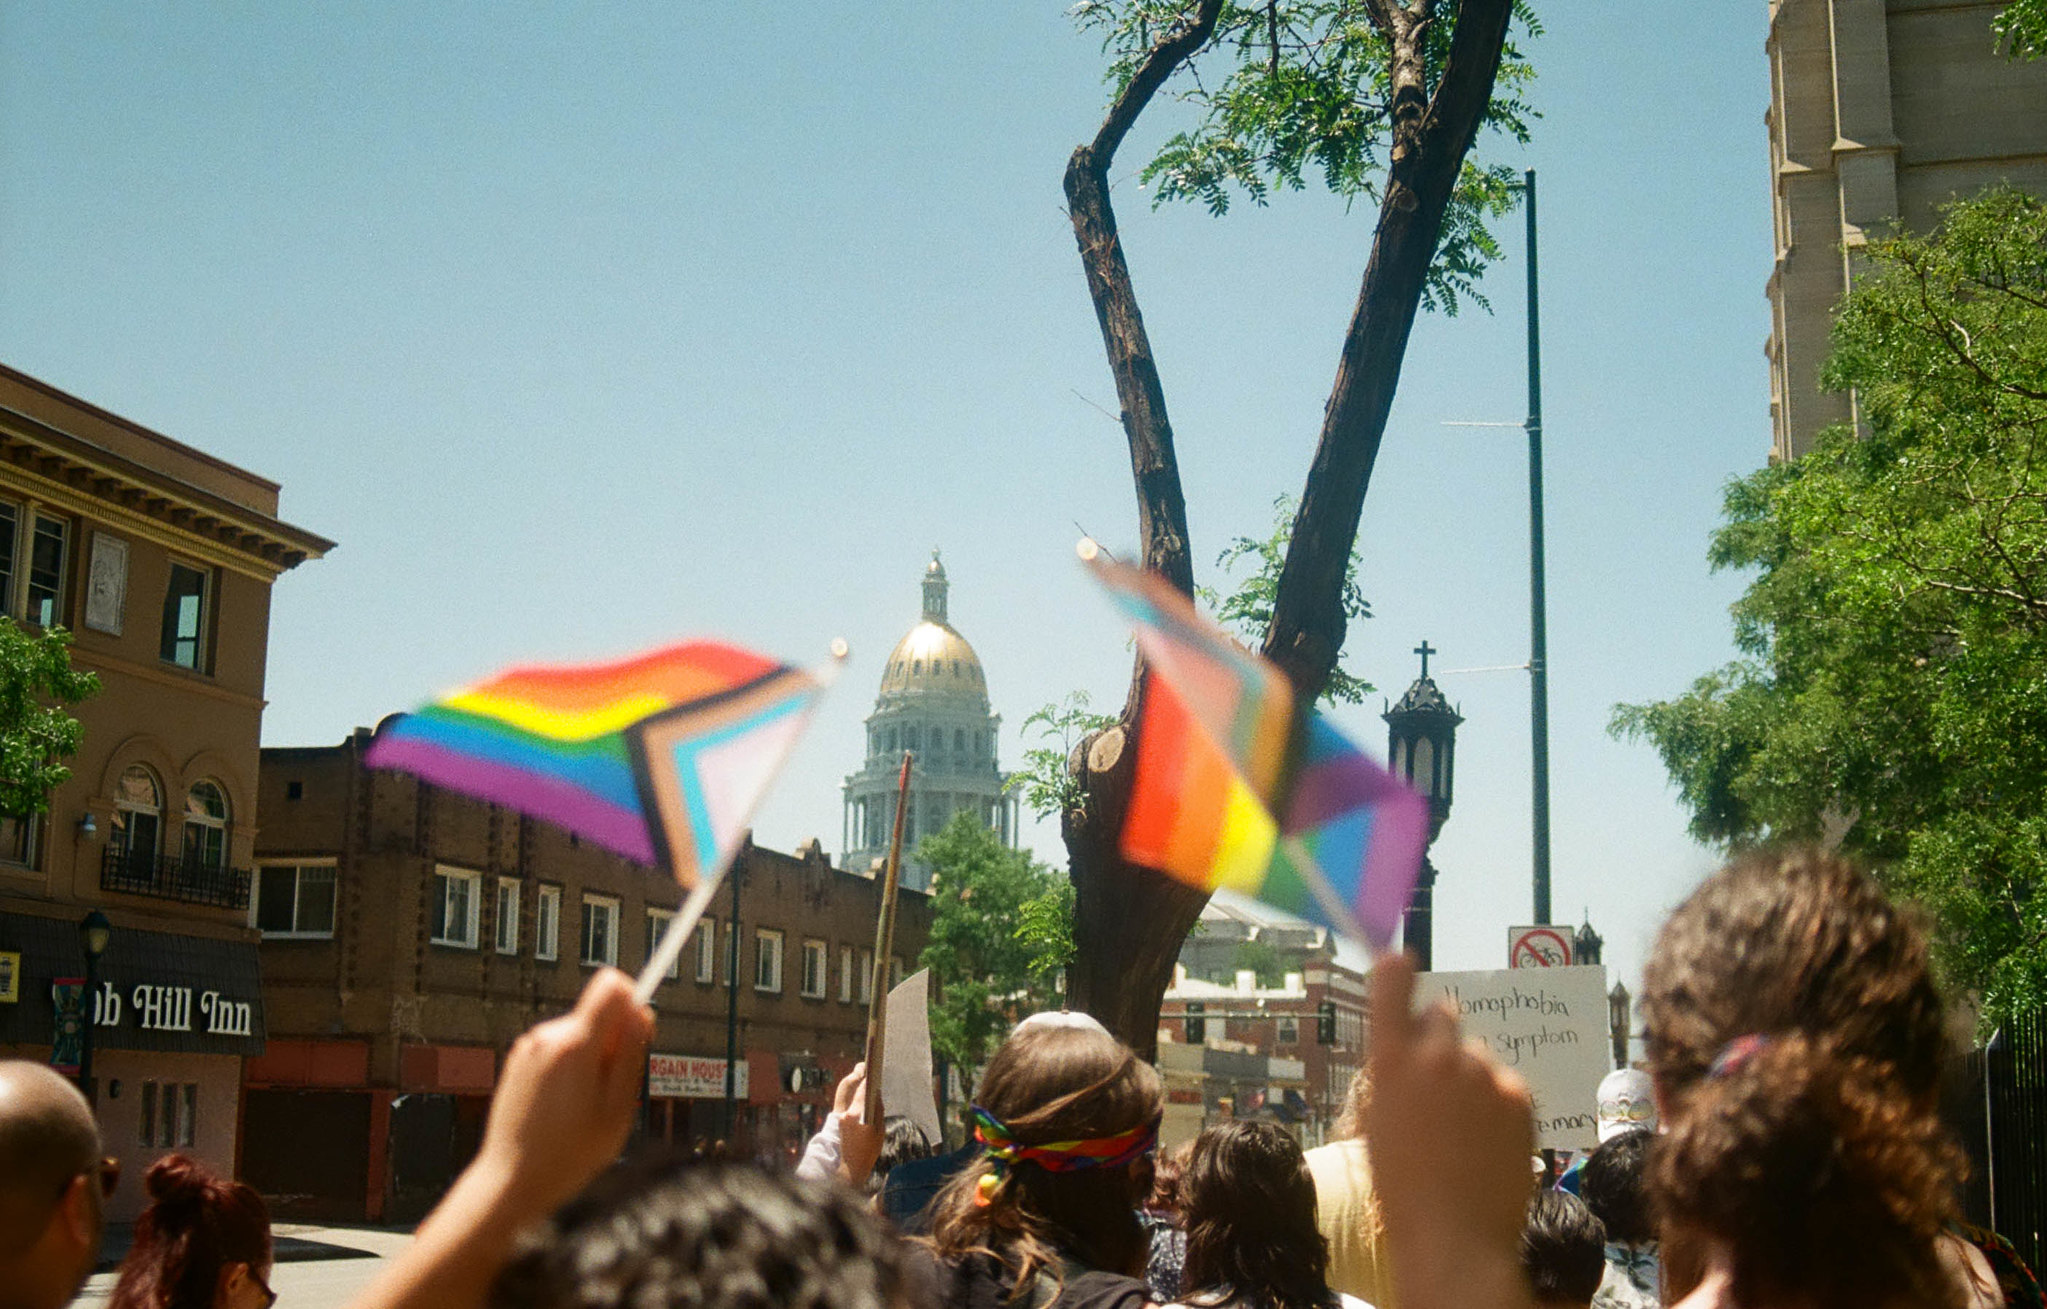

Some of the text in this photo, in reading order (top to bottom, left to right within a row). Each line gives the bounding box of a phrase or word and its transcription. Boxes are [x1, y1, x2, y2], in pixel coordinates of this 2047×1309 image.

[133, 984, 192, 1031] Hill
[201, 990, 251, 1036] Inn
[1497, 1025, 1579, 1065] symptom
[650, 1057, 689, 1077] RGAIN
